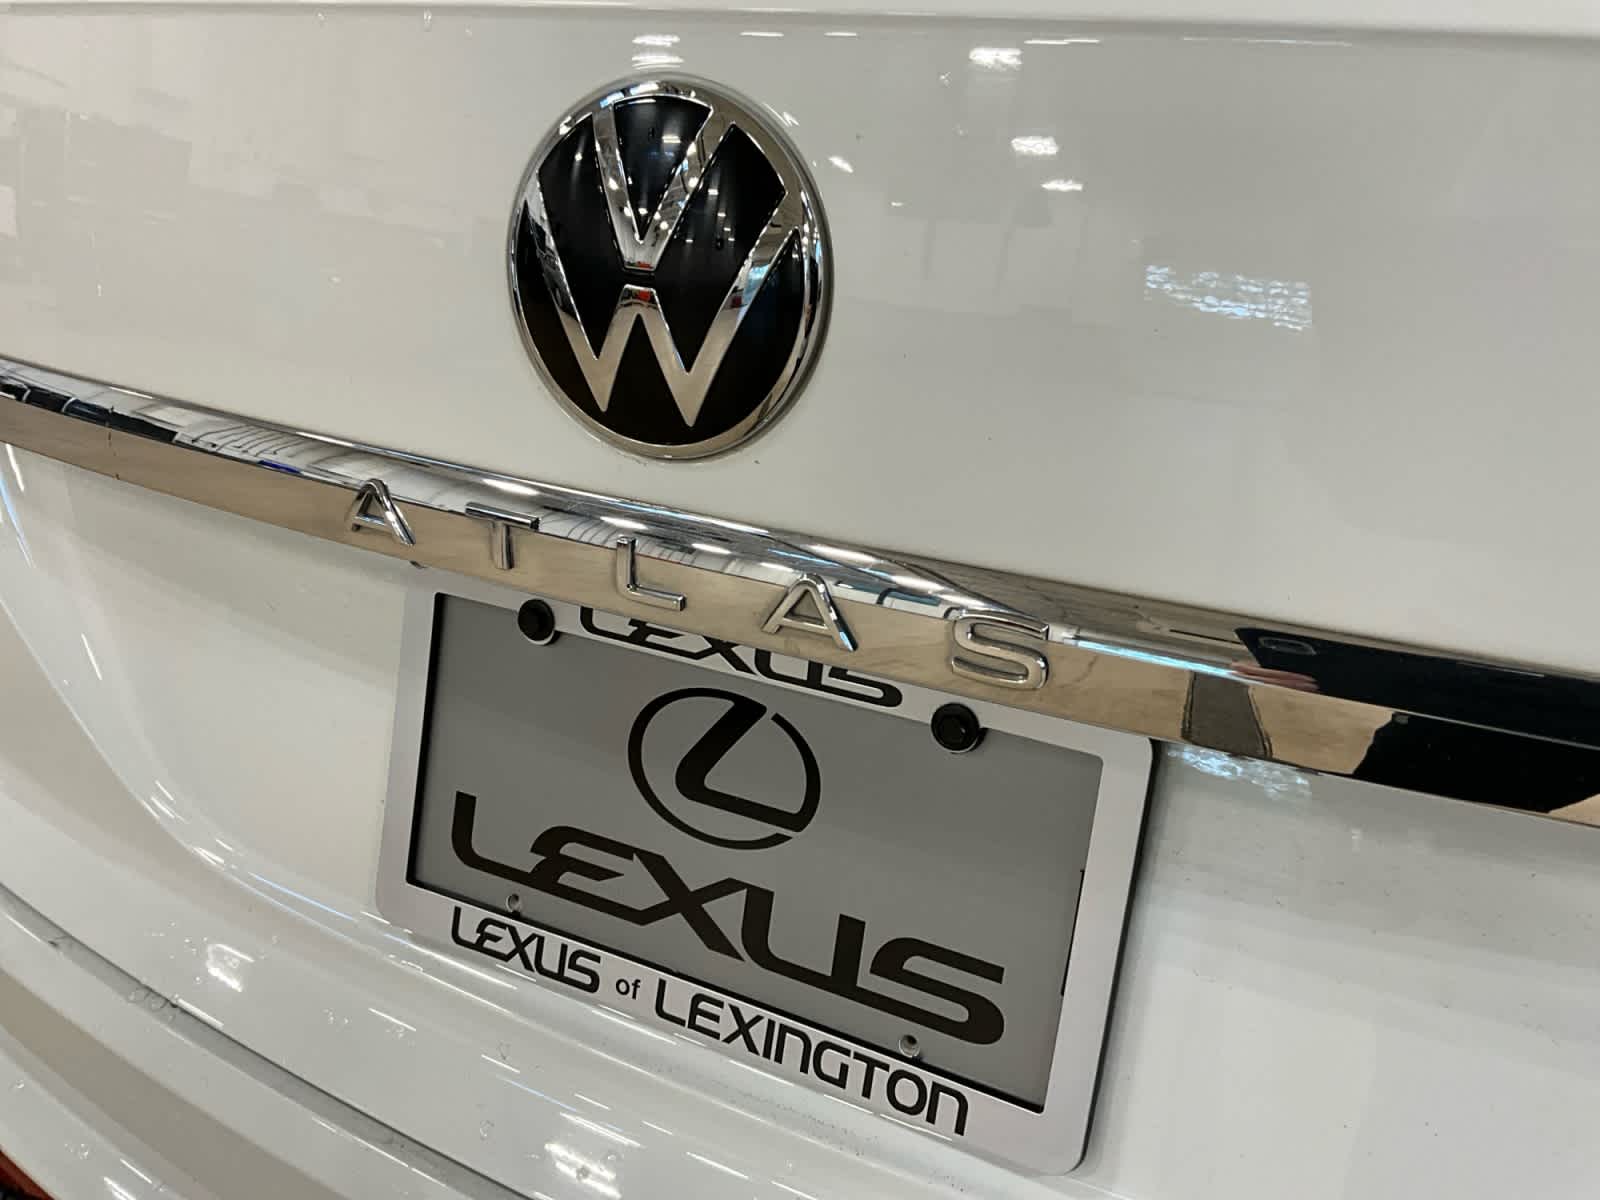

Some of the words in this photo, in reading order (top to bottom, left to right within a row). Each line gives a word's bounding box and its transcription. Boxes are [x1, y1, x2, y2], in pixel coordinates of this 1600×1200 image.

[350, 477, 1050, 690] ATLAS
[451, 790, 1005, 1045] LEXUS
[452, 907, 601, 994] LEXUS
[614, 977, 642, 1000] of
[654, 979, 968, 1136] LEXINGTON
